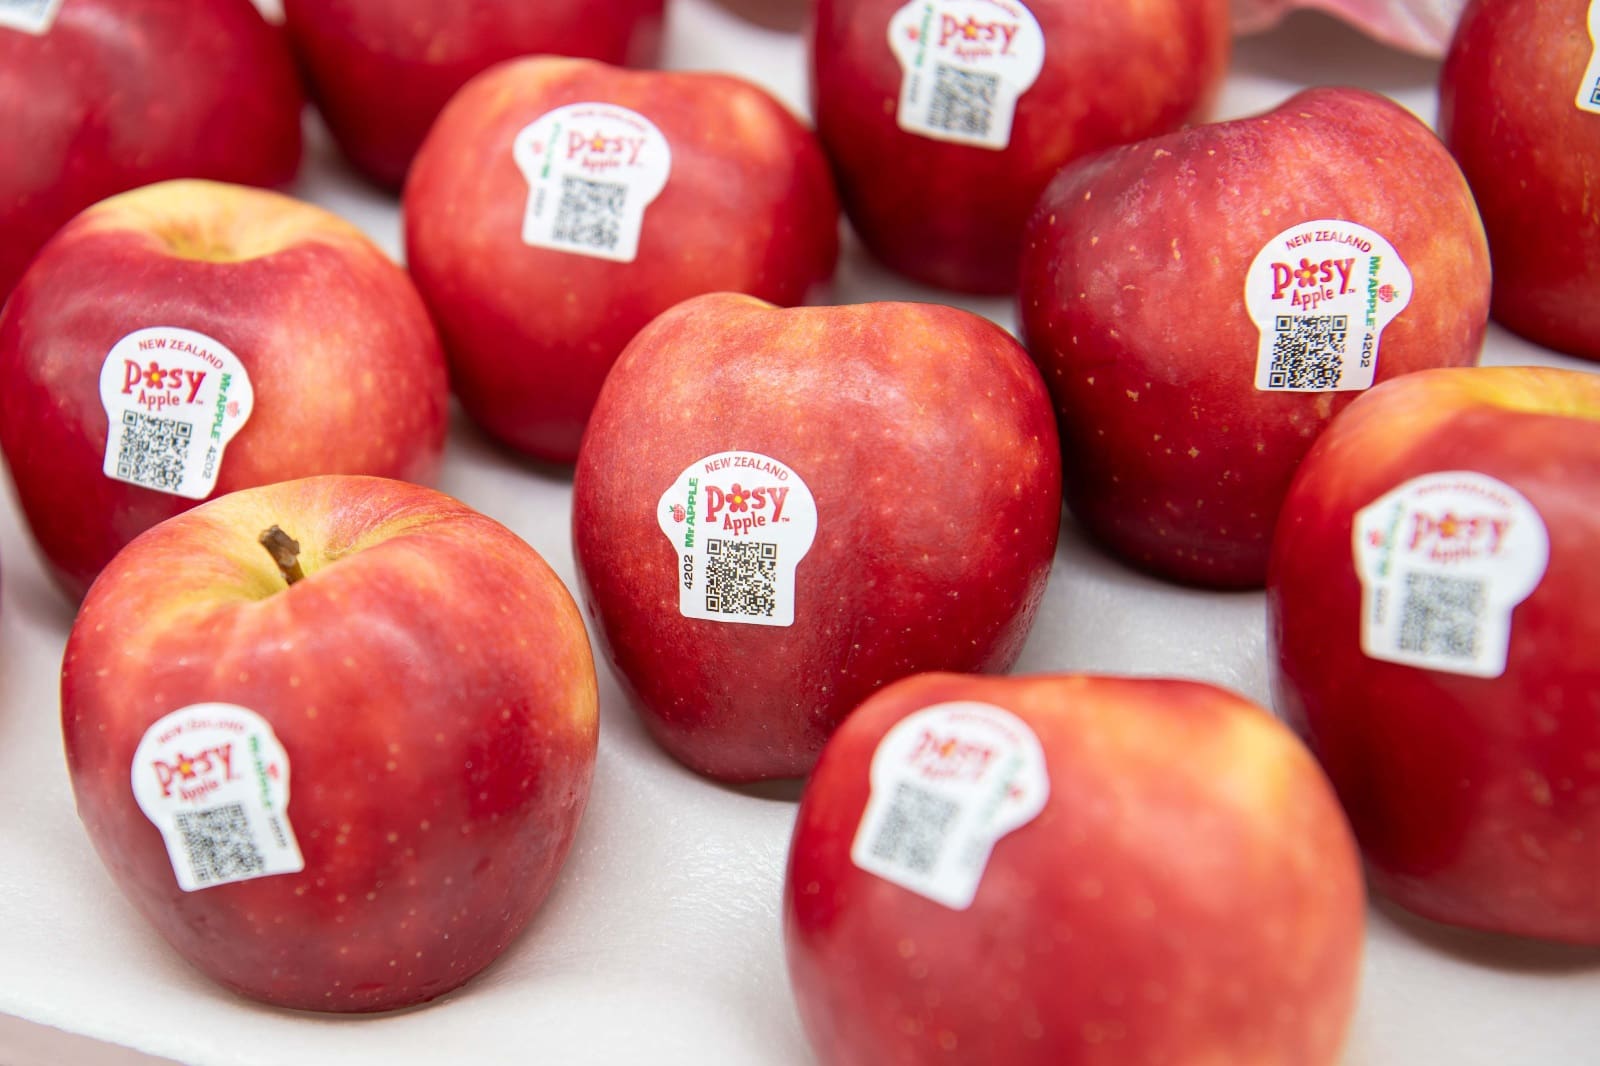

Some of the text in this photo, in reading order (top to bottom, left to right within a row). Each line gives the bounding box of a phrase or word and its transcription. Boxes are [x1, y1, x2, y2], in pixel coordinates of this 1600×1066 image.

[1286, 231, 1372, 253] NEW ZEALAND
[1291, 285, 1334, 311] Apple
[1366, 256, 1382, 327] Mr APPLE
[139, 339, 224, 370] NEW ZEALAND
[1360, 333, 1374, 368] 4202
[138, 390, 180, 411] Apple
[211, 393, 228, 439] APPLE
[202, 445, 217, 479] 4202
[705, 456, 789, 481] NEW ZEALAND
[685, 477, 699, 548] Mr APPLE
[723, 511, 766, 536] Apple
[684, 554, 694, 590] 4202
